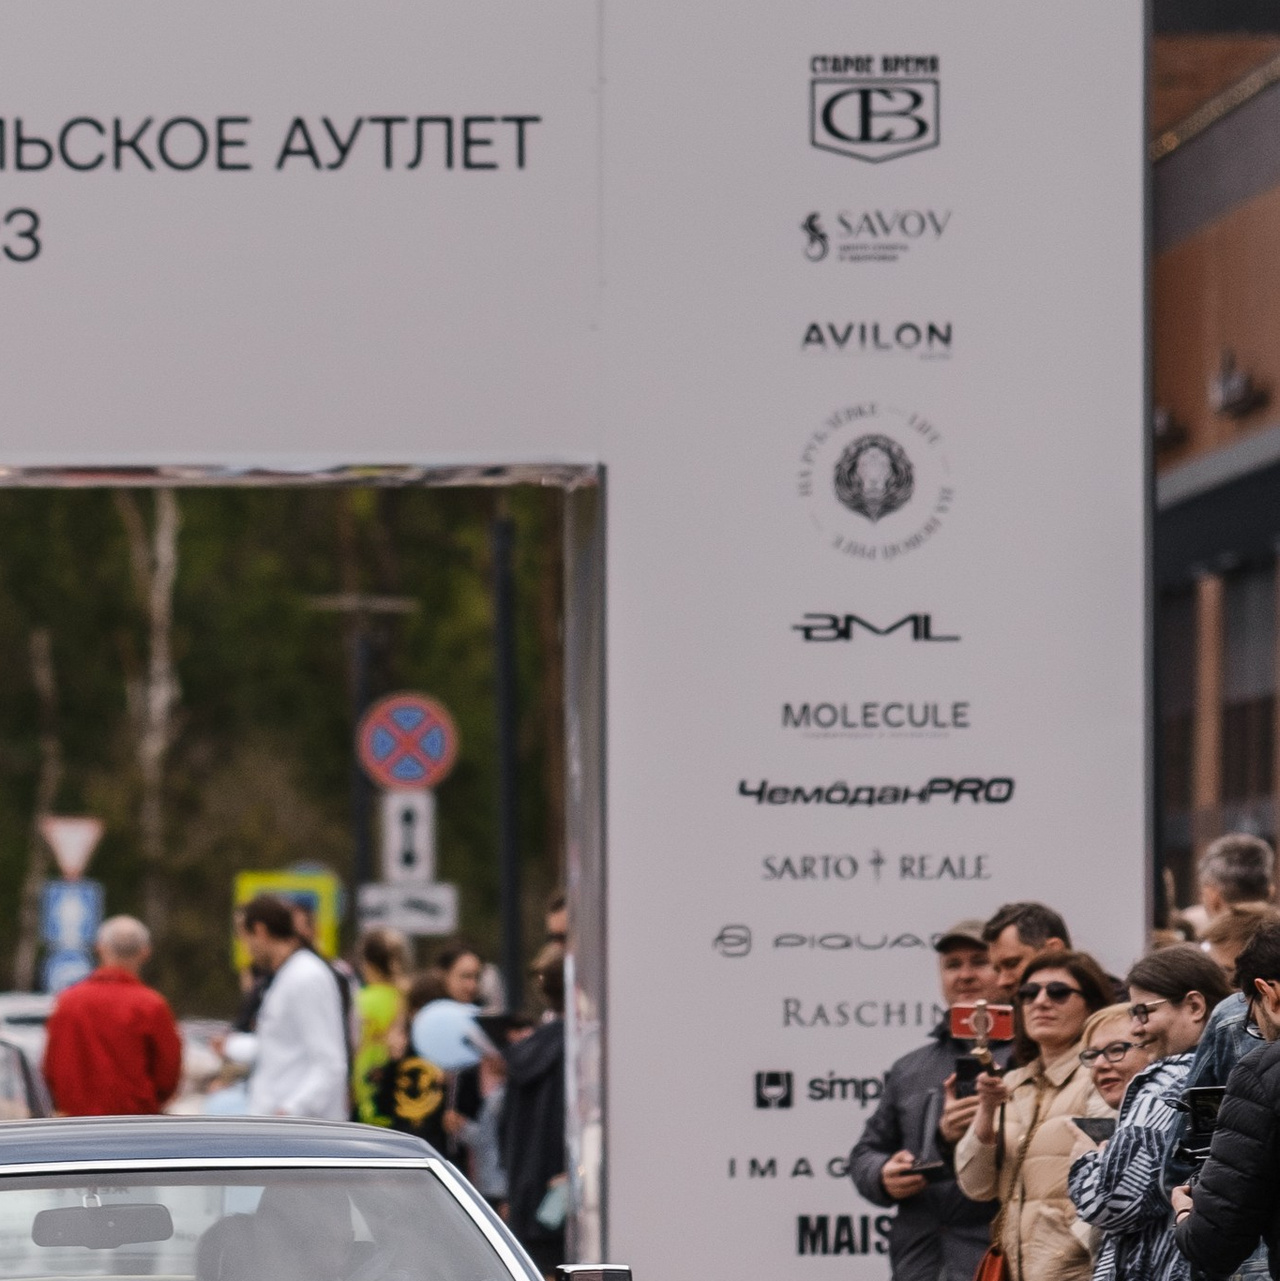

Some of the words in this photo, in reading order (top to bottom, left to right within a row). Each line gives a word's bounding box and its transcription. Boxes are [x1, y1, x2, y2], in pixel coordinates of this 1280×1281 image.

[275, 116, 541, 171] АУТЛЕТ
[802, 322, 953, 350] AVILON
[792, 613, 961, 642] BML
[781, 702, 970, 729] MOLECULE
[762, 854, 858, 881] SARTO
[898, 854, 992, 881] REALE
